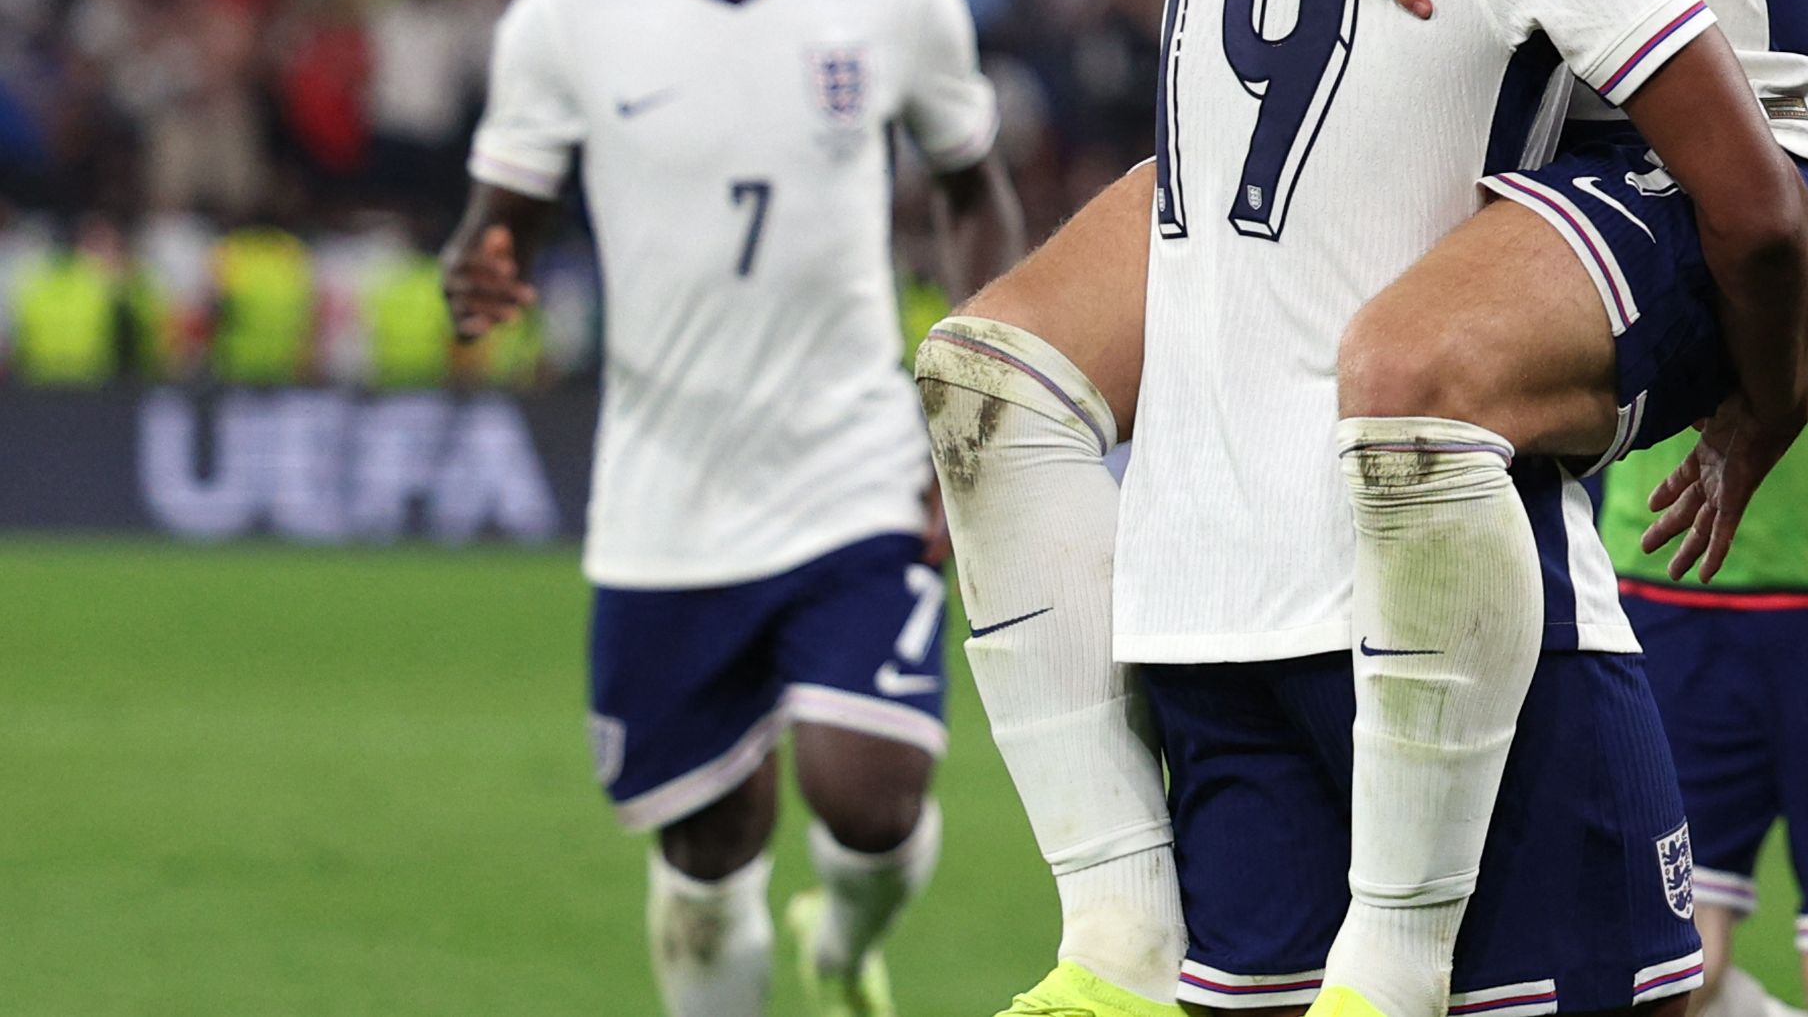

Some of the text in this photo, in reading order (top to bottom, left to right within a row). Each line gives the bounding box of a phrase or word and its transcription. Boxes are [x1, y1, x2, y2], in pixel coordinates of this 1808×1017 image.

[730, 178, 773, 277] 7
[137, 385, 566, 544] UEFA
[893, 562, 946, 667] 7
